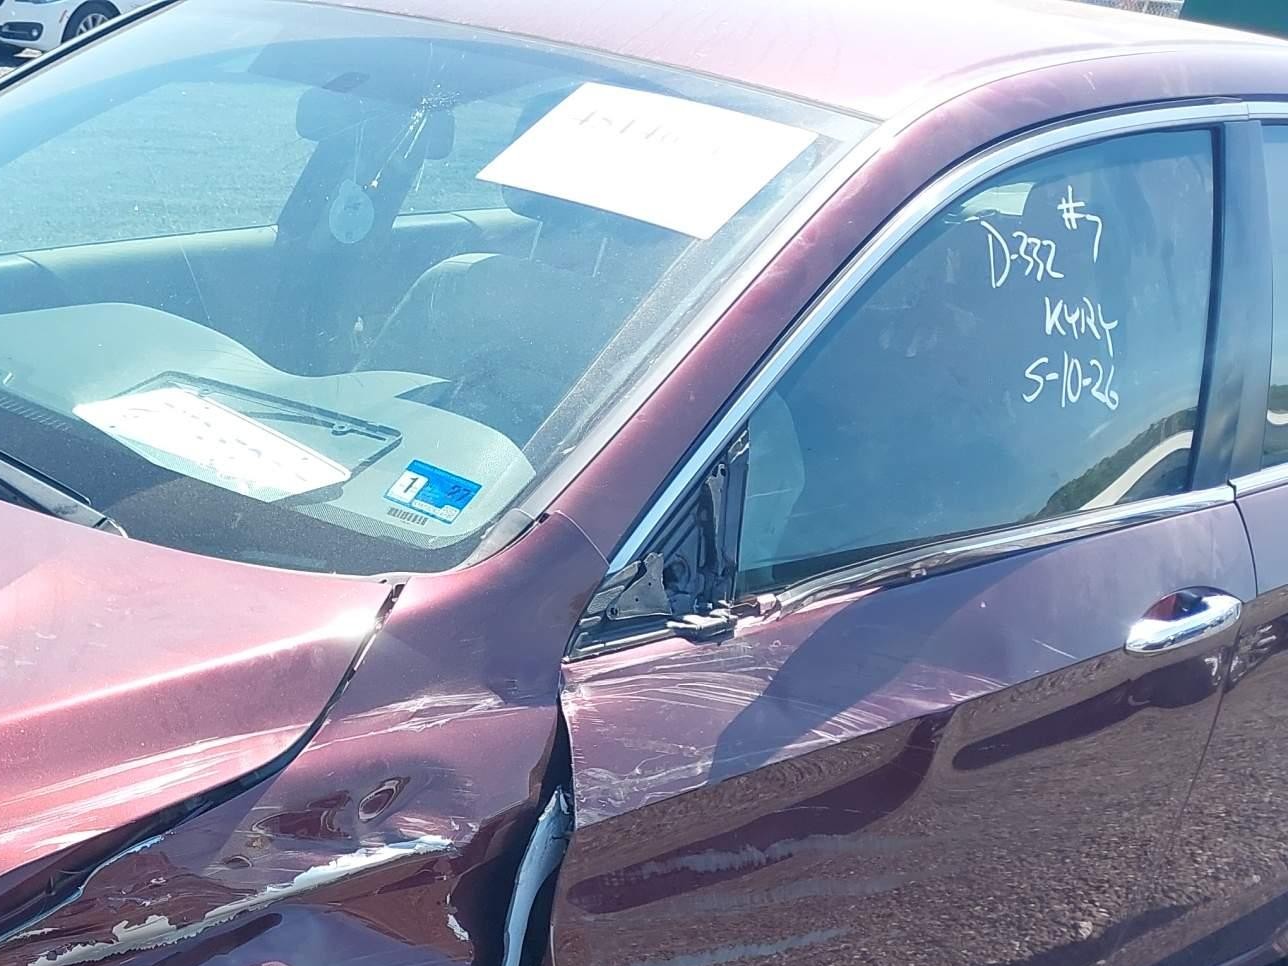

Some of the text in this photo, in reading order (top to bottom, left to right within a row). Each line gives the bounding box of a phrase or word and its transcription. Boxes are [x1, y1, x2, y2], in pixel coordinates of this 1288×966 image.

[980, 220, 1065, 289] D-332
[1057, 185, 1103, 263] #7
[403, 477, 419, 494] 1
